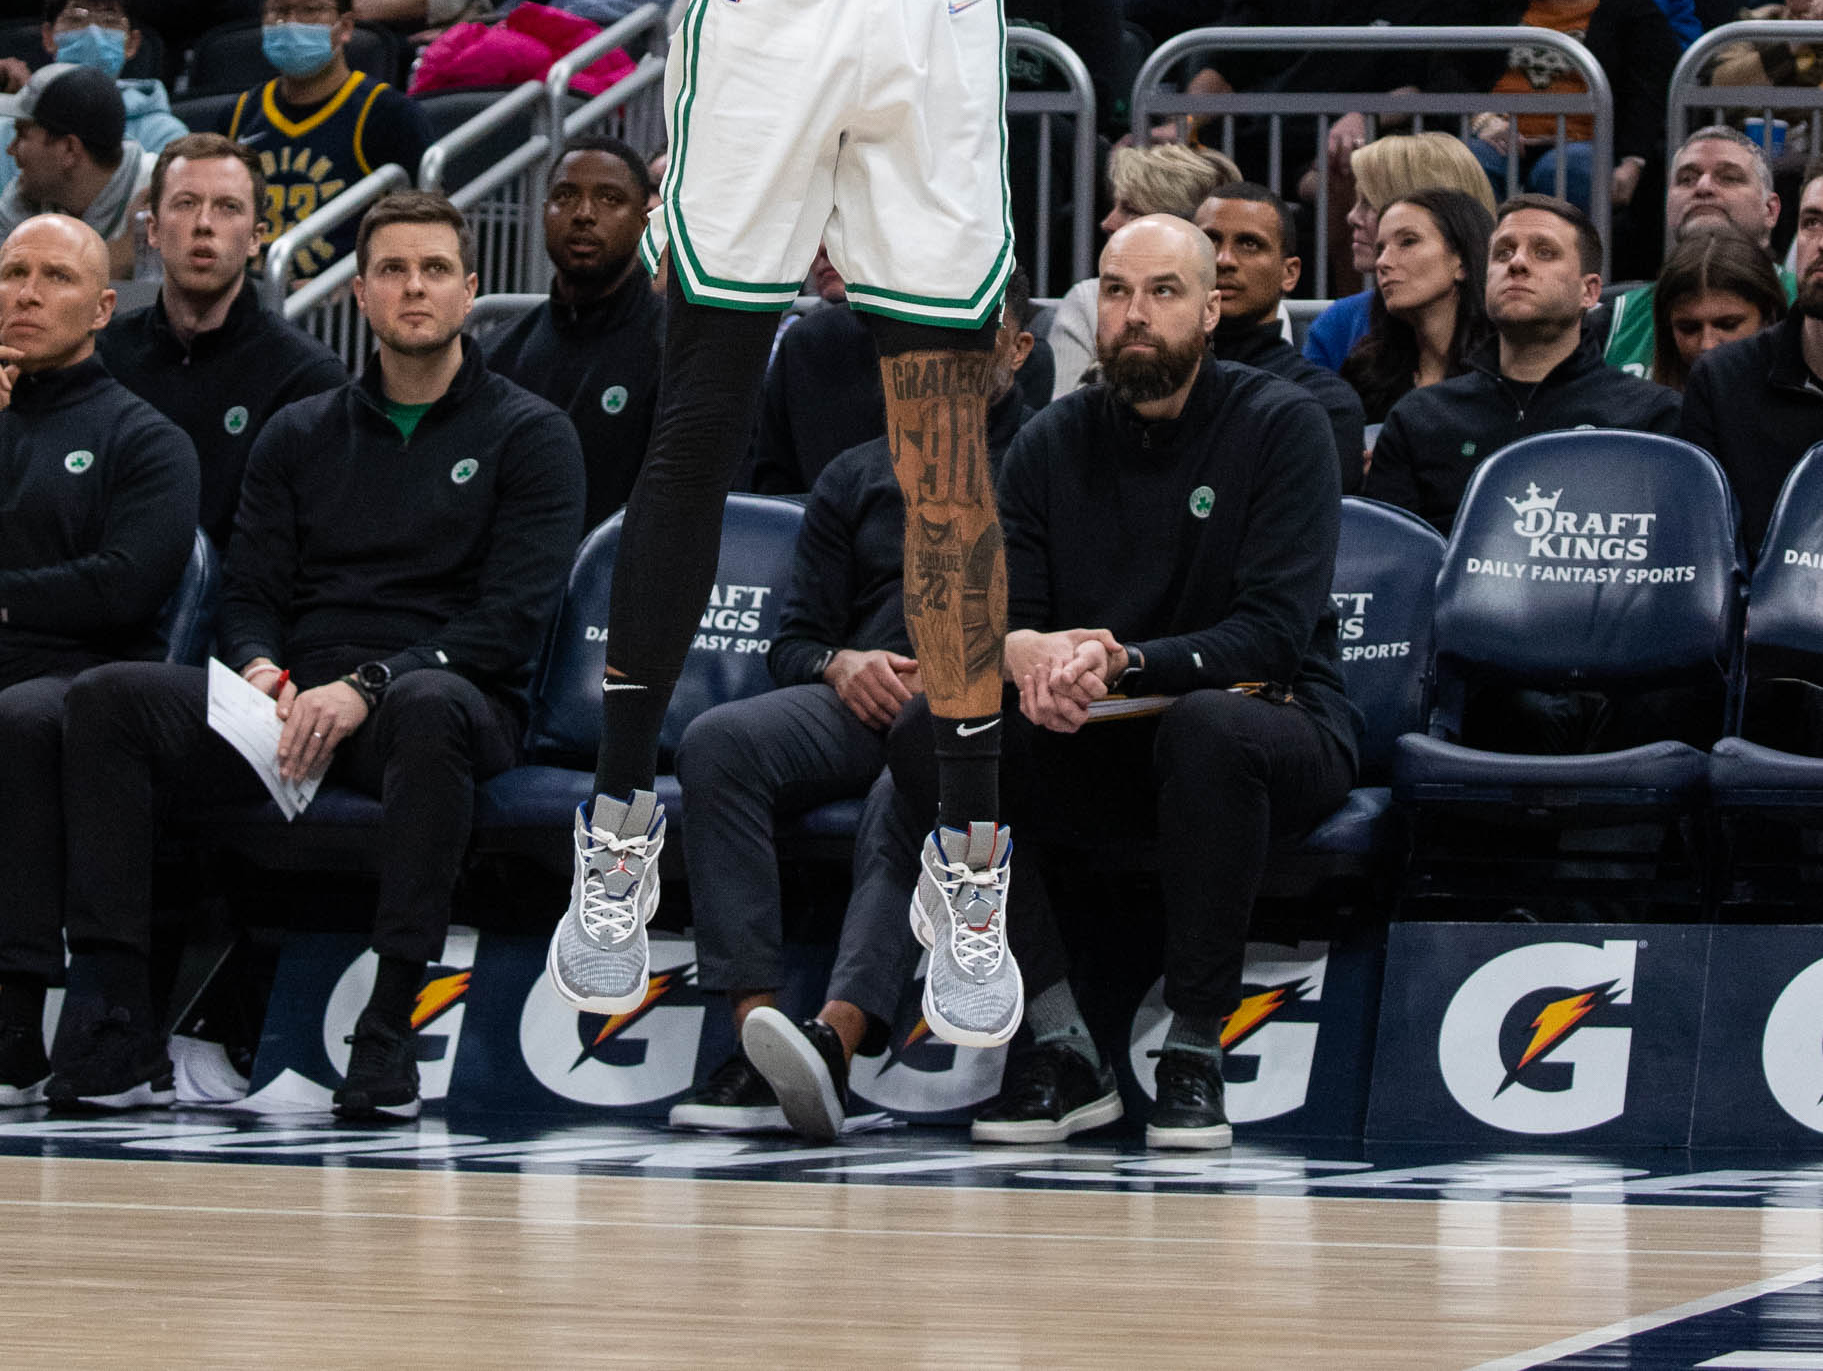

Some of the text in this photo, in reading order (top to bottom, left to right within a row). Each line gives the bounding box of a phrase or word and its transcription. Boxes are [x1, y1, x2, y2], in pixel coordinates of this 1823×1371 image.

[1513, 509, 1656, 537] DRAFT
[1528, 533, 1648, 561] KINGS
[1784, 549, 1823, 569] DAI
[1467, 558, 1696, 585] DAILY FANTASY SPORTS
[734, 639, 771, 653] SPO
[1342, 641, 1411, 661] SPORTS
[519, 932, 706, 1106] G
[1438, 940, 1638, 1134] G
